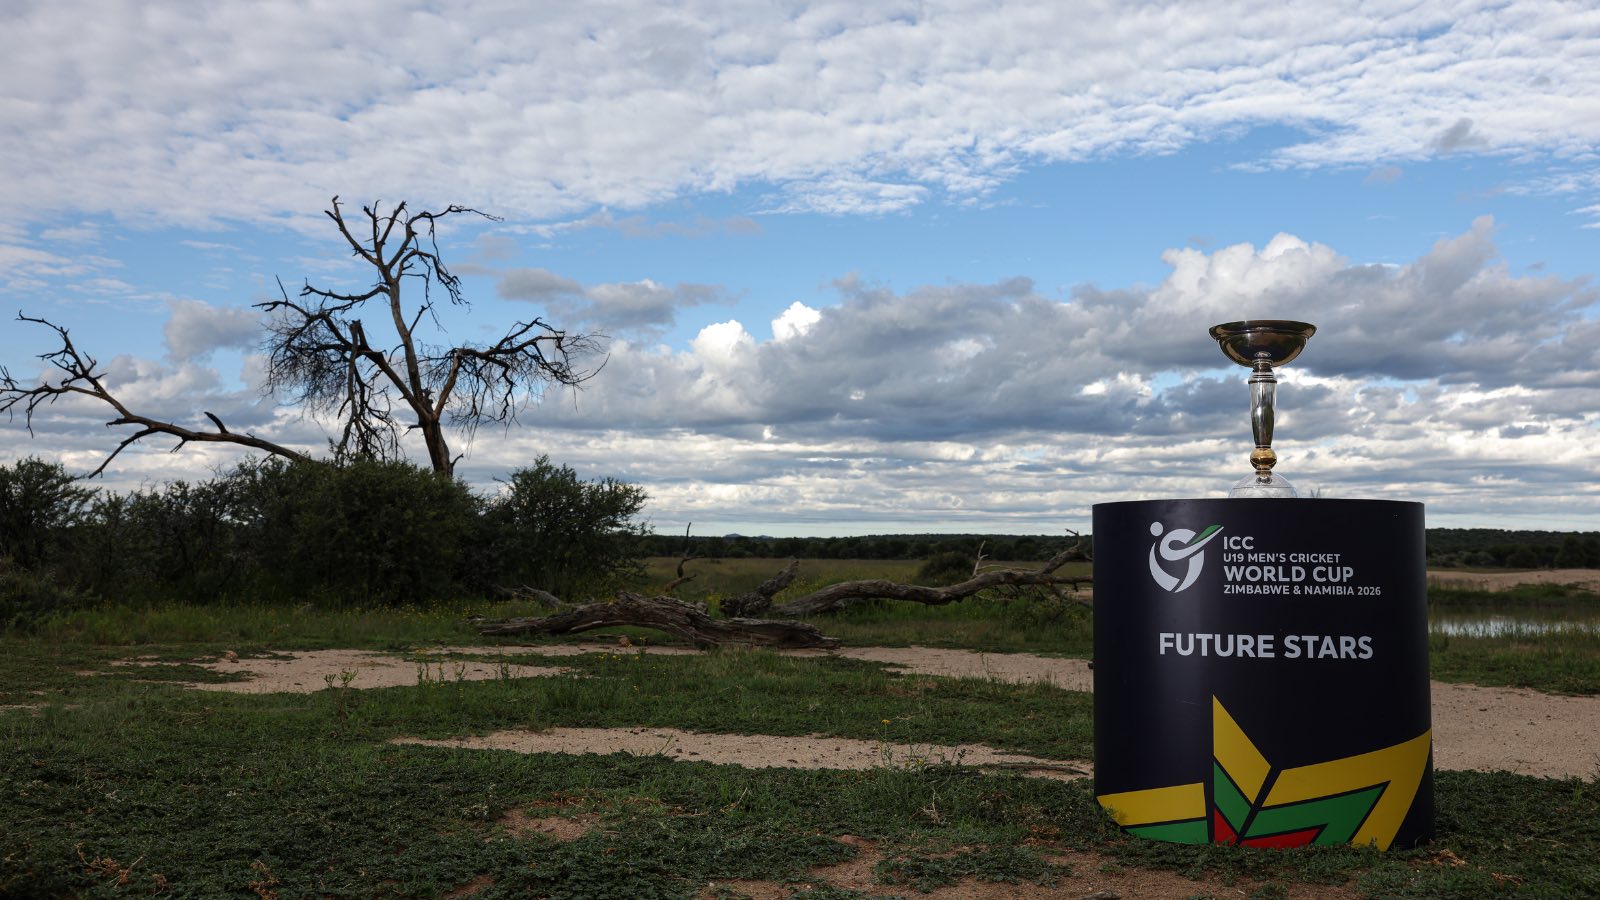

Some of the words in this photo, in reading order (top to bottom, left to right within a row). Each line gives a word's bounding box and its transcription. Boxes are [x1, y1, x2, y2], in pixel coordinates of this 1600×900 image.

[1223, 536, 1254, 550] ICC
[1223, 553, 1244, 563] U19
[1248, 553, 1286, 563] MEN'S
[1289, 553, 1341, 563] CRICKET
[1223, 565, 1306, 582] WORLD
[1312, 566, 1354, 583] CUP
[1223, 585, 1290, 595] ZIMBABWE
[1293, 585, 1302, 595] &
[1304, 585, 1355, 596] NAMIBIA
[1357, 586, 1381, 596] 2026
[1159, 632, 1275, 658] FUTURE
[1284, 635, 1374, 660] STARS
